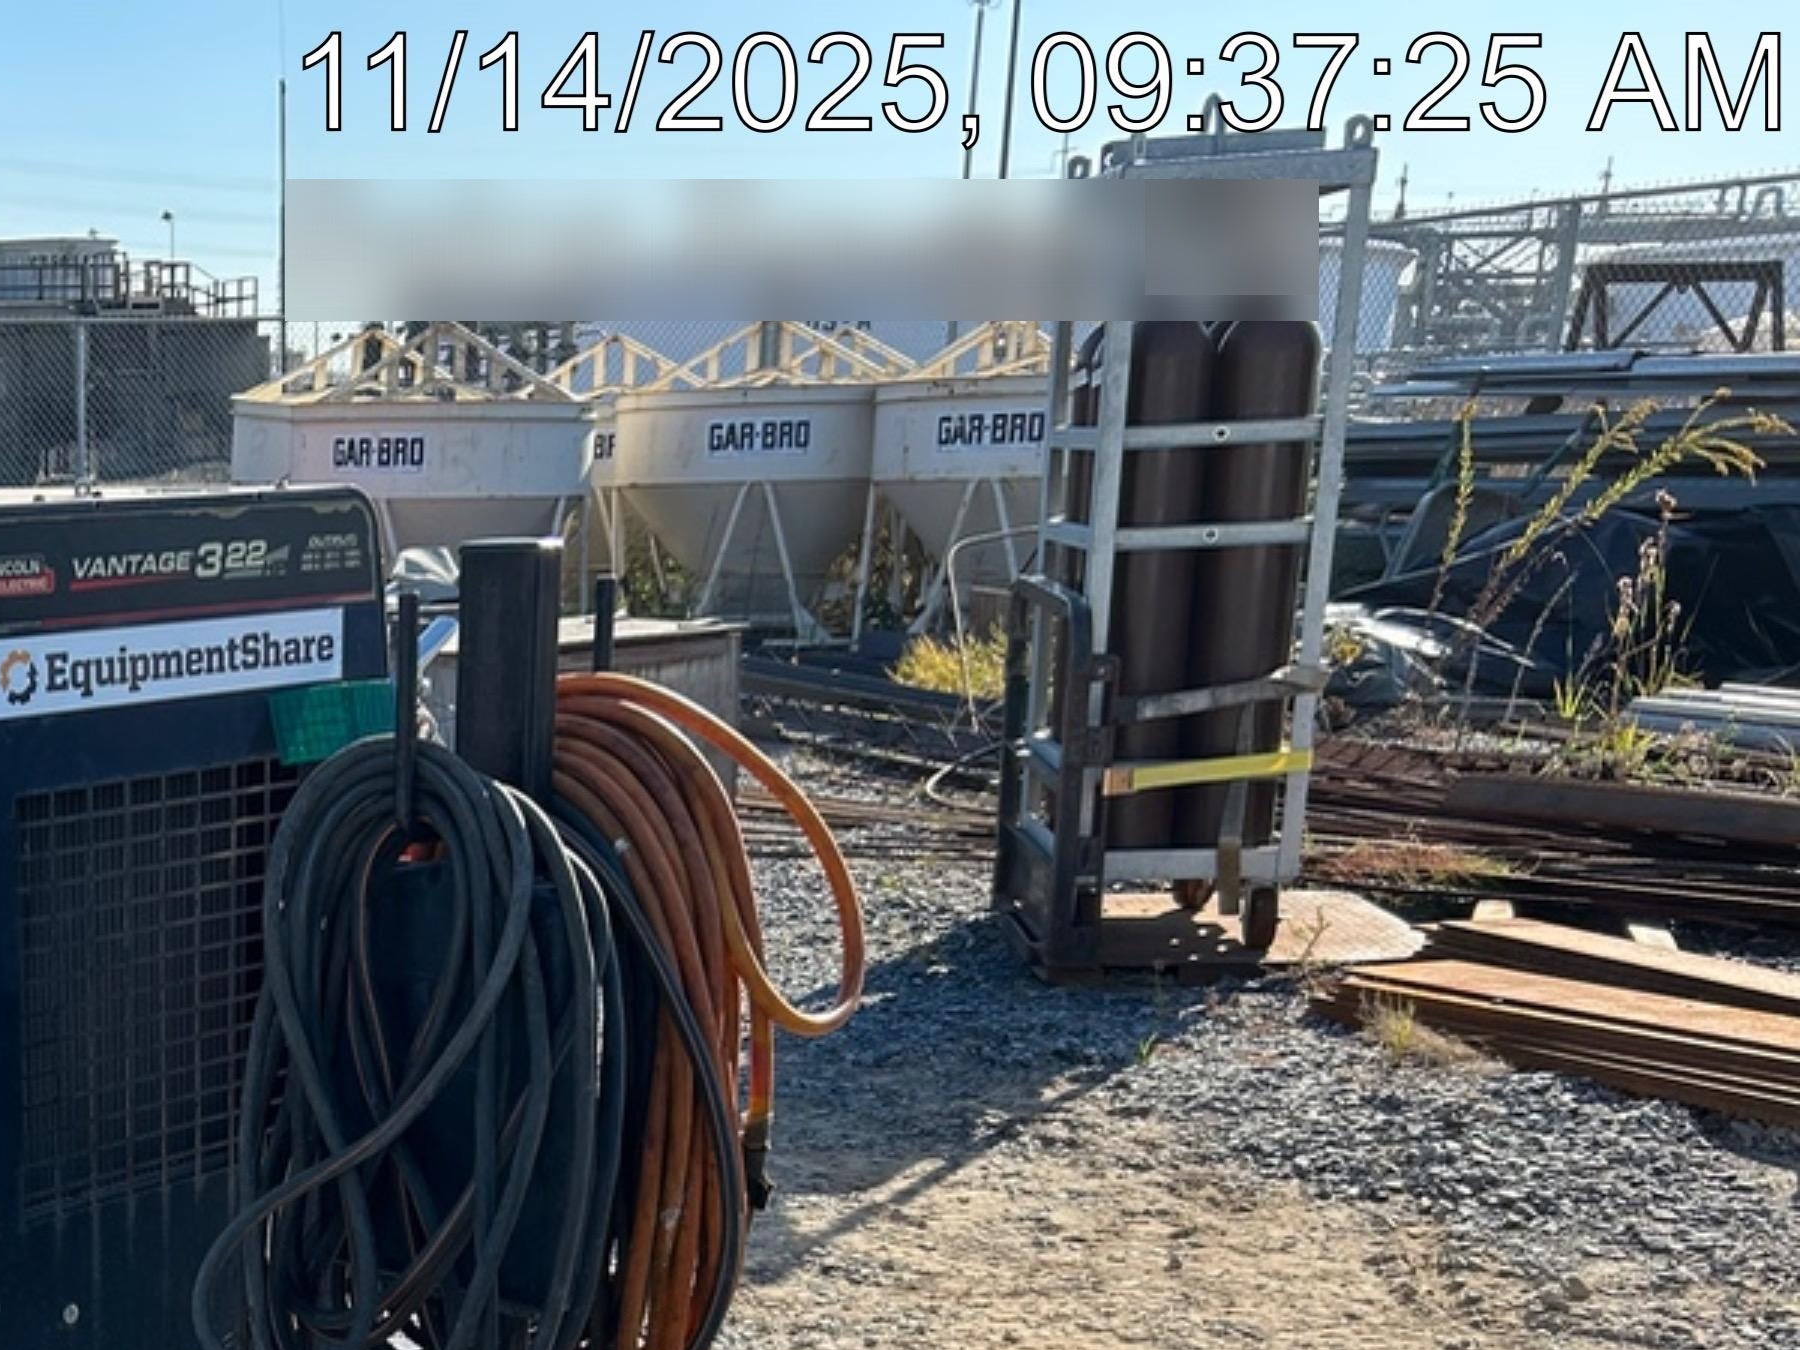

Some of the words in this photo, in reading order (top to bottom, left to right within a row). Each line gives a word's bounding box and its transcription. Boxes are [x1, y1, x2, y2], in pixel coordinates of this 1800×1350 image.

[71, 551, 194, 579] VANTAGE
[194, 539, 268, 578] 322
[44, 631, 335, 698] EquipmentShare
